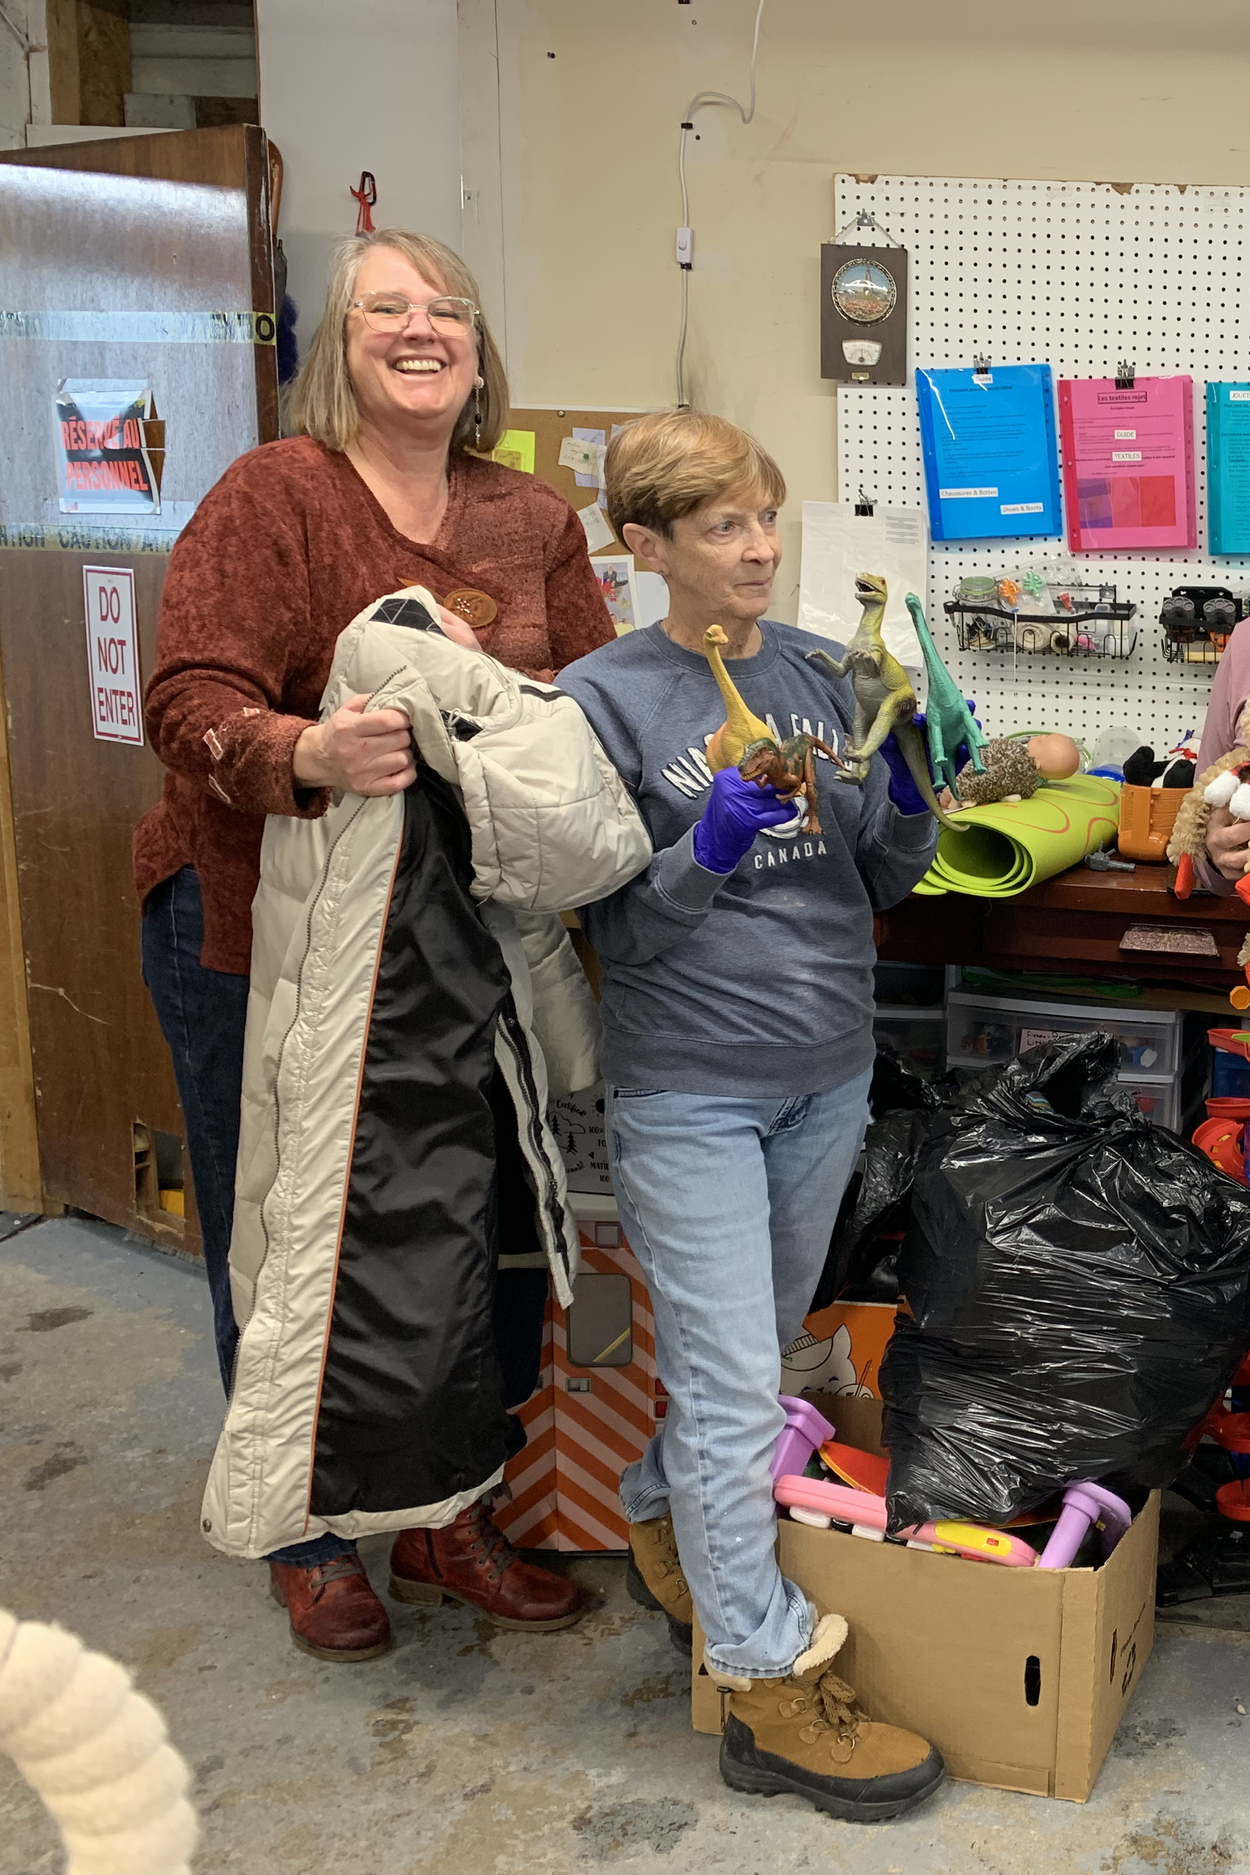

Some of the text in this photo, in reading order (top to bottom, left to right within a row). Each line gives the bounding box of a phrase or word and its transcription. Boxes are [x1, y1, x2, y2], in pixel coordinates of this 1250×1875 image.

[123, 418, 140, 448] AU
[66, 461, 148, 491] PERSONNEL
[98, 586, 121, 624] DO
[97, 637, 127, 675] NOT
[97, 687, 136, 727] ENTER
[754, 840, 827, 870] CANADA
